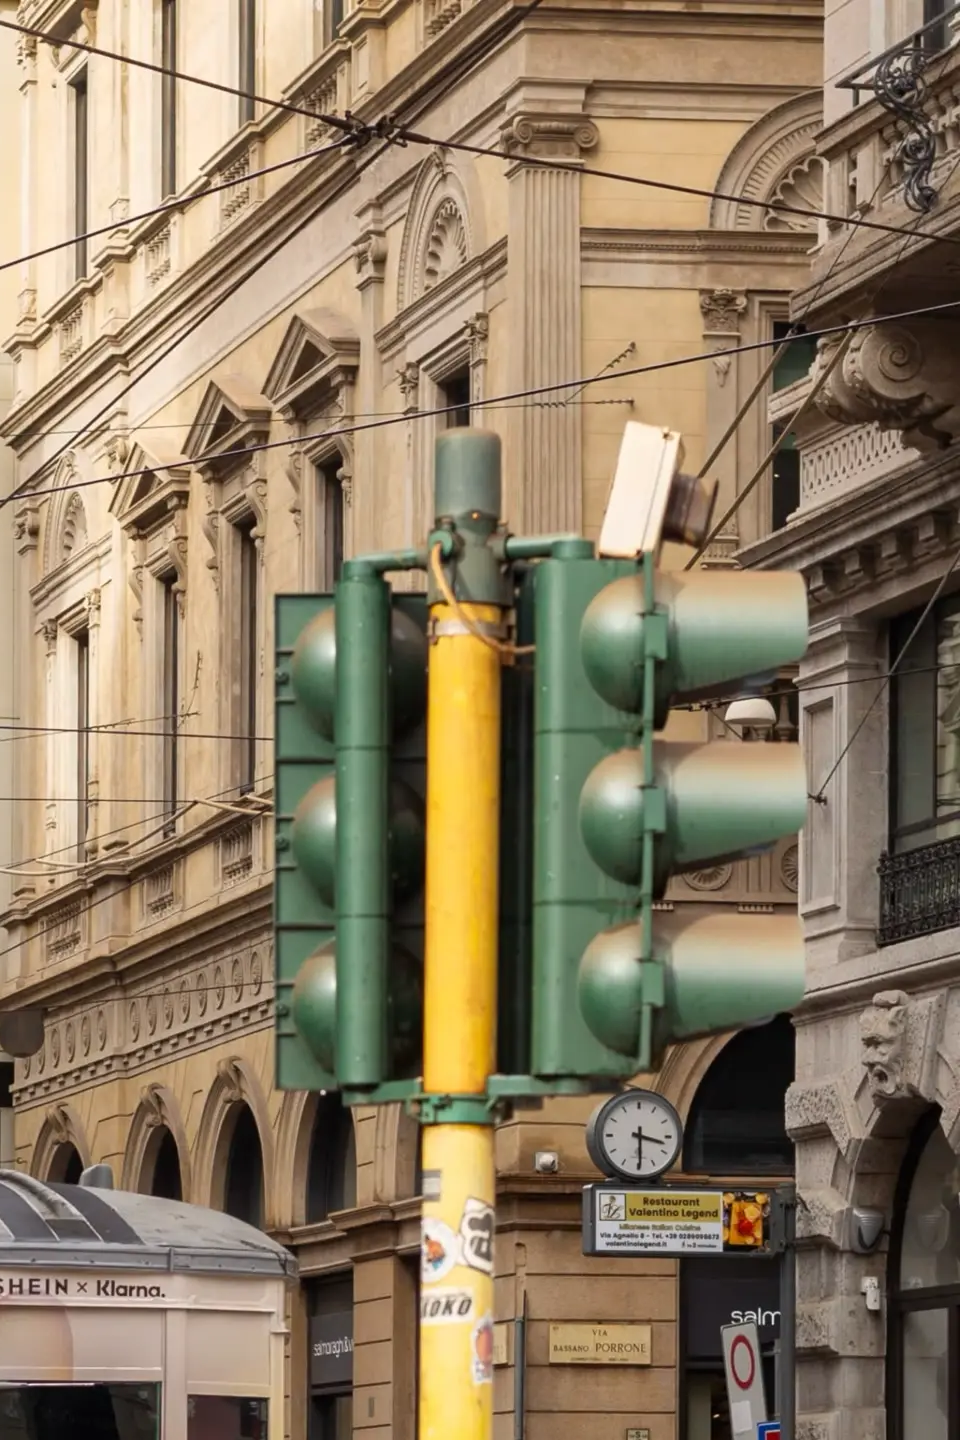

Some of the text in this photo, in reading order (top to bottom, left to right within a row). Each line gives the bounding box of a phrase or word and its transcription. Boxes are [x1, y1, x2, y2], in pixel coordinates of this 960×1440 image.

[642, 1196, 700, 1207] Restaurant
[629, 1207, 719, 1219] Valentino Legend
[605, 1240, 667, 1249] valentinolegend.it
[96, 1279, 166, 1298] Klarna.
[591, 1328, 608, 1337] VIA
[553, 1342, 647, 1353] BASSANO PORRONE
